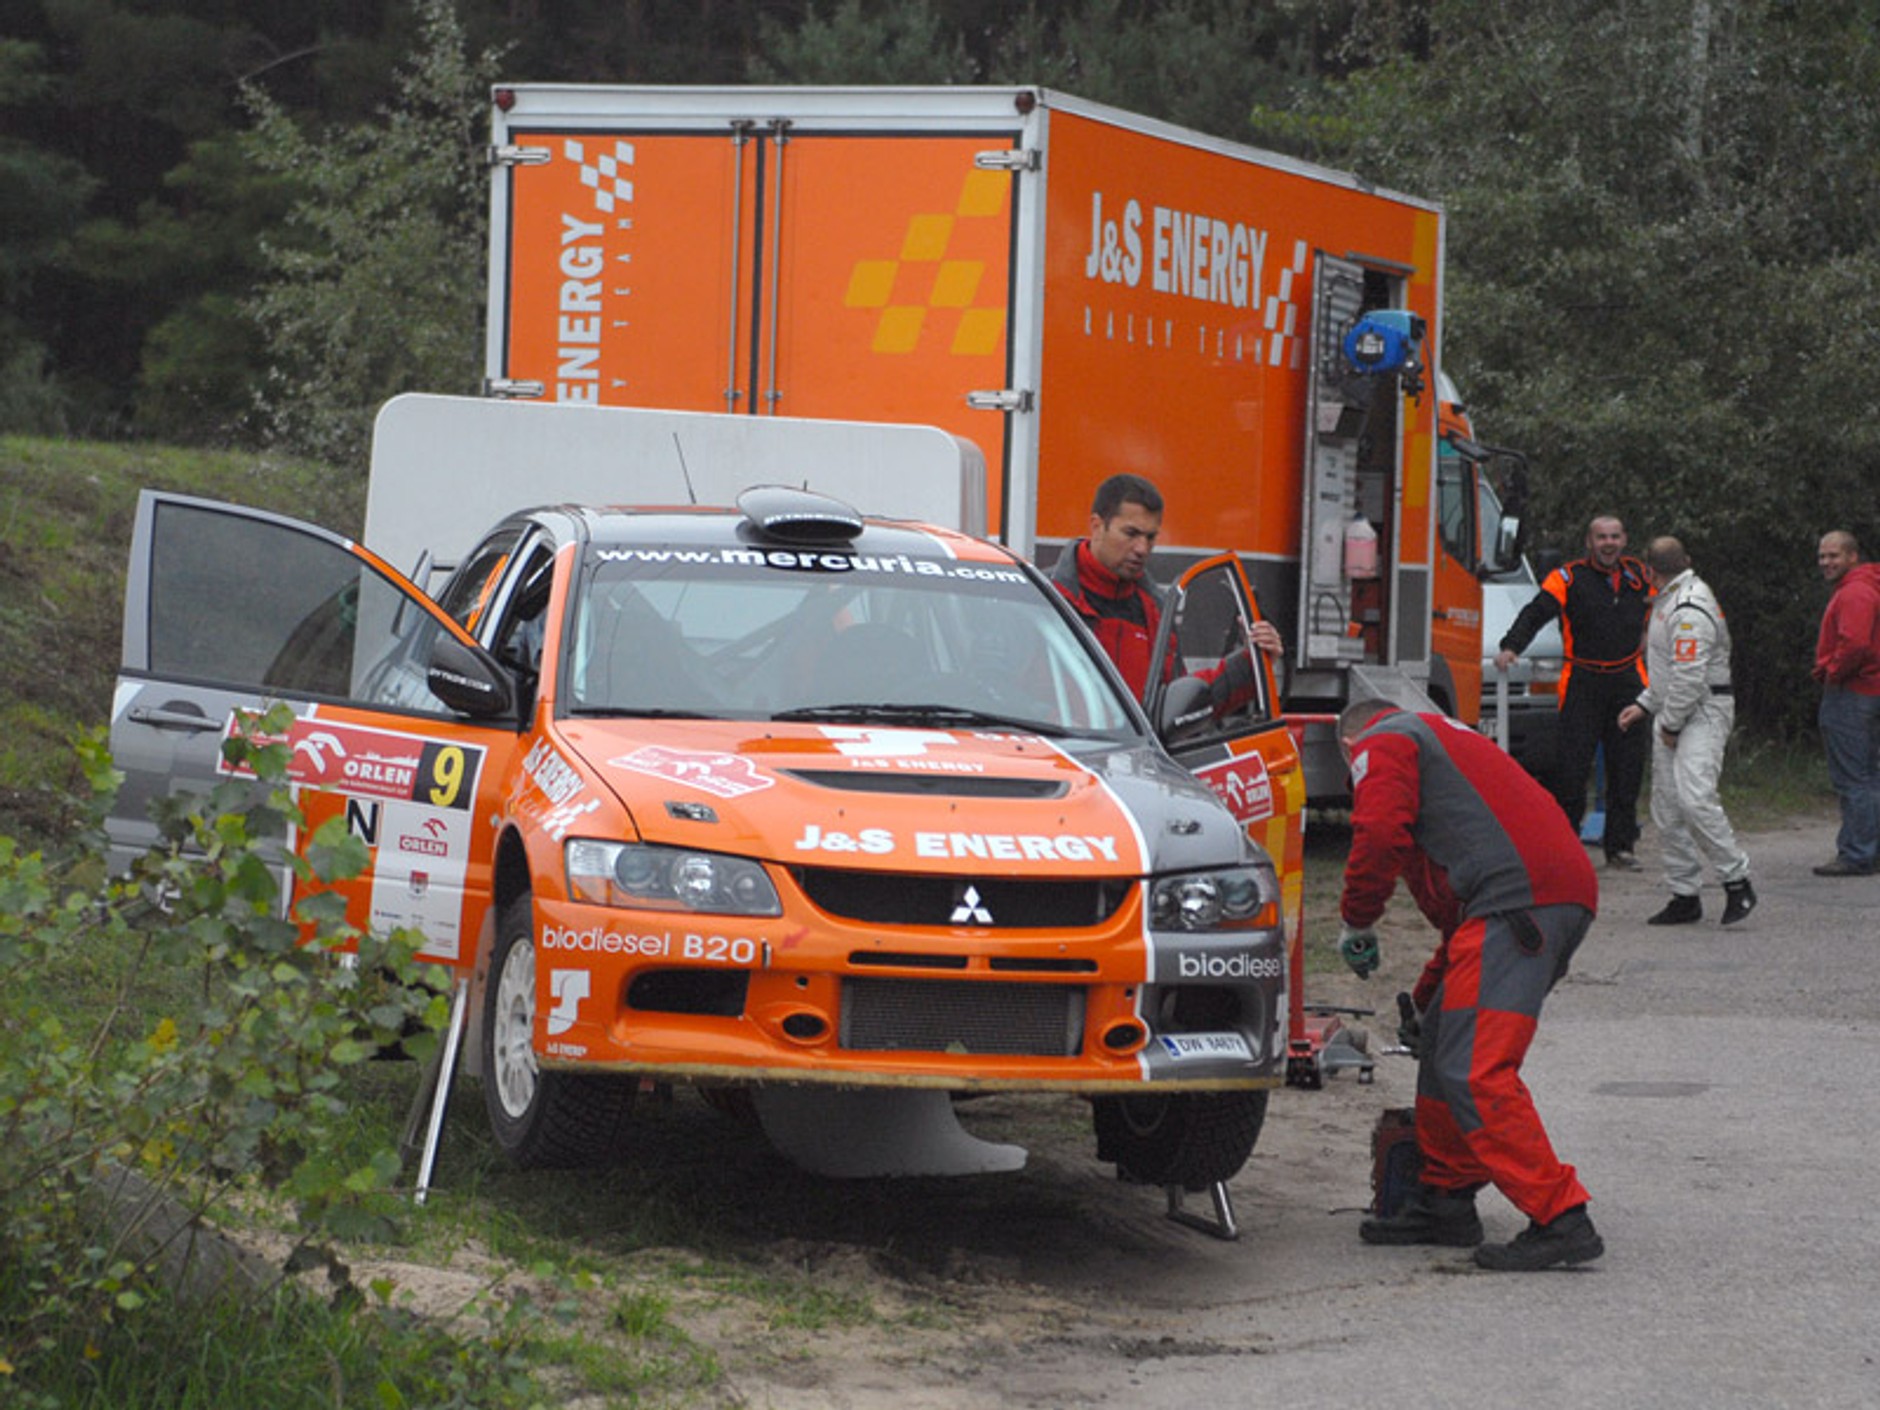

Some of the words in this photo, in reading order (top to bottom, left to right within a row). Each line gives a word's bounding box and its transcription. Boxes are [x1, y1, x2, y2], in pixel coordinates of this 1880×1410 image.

[1085, 191, 1142, 287] J&S
[1153, 206, 1268, 310] ENERGY
[556, 212, 605, 406] ENERGY
[596, 547, 1029, 585] www.mercuria.com
[343, 760, 412, 786] ORLEN
[429, 746, 466, 807] 9
[896, 759, 984, 773] ENERGY
[346, 798, 380, 845] N
[401, 837, 447, 855] ORLEN
[794, 824, 896, 855] J&S
[914, 831, 1119, 862] ENERGY
[541, 924, 671, 957] biodiesel
[683, 933, 757, 964] B20
